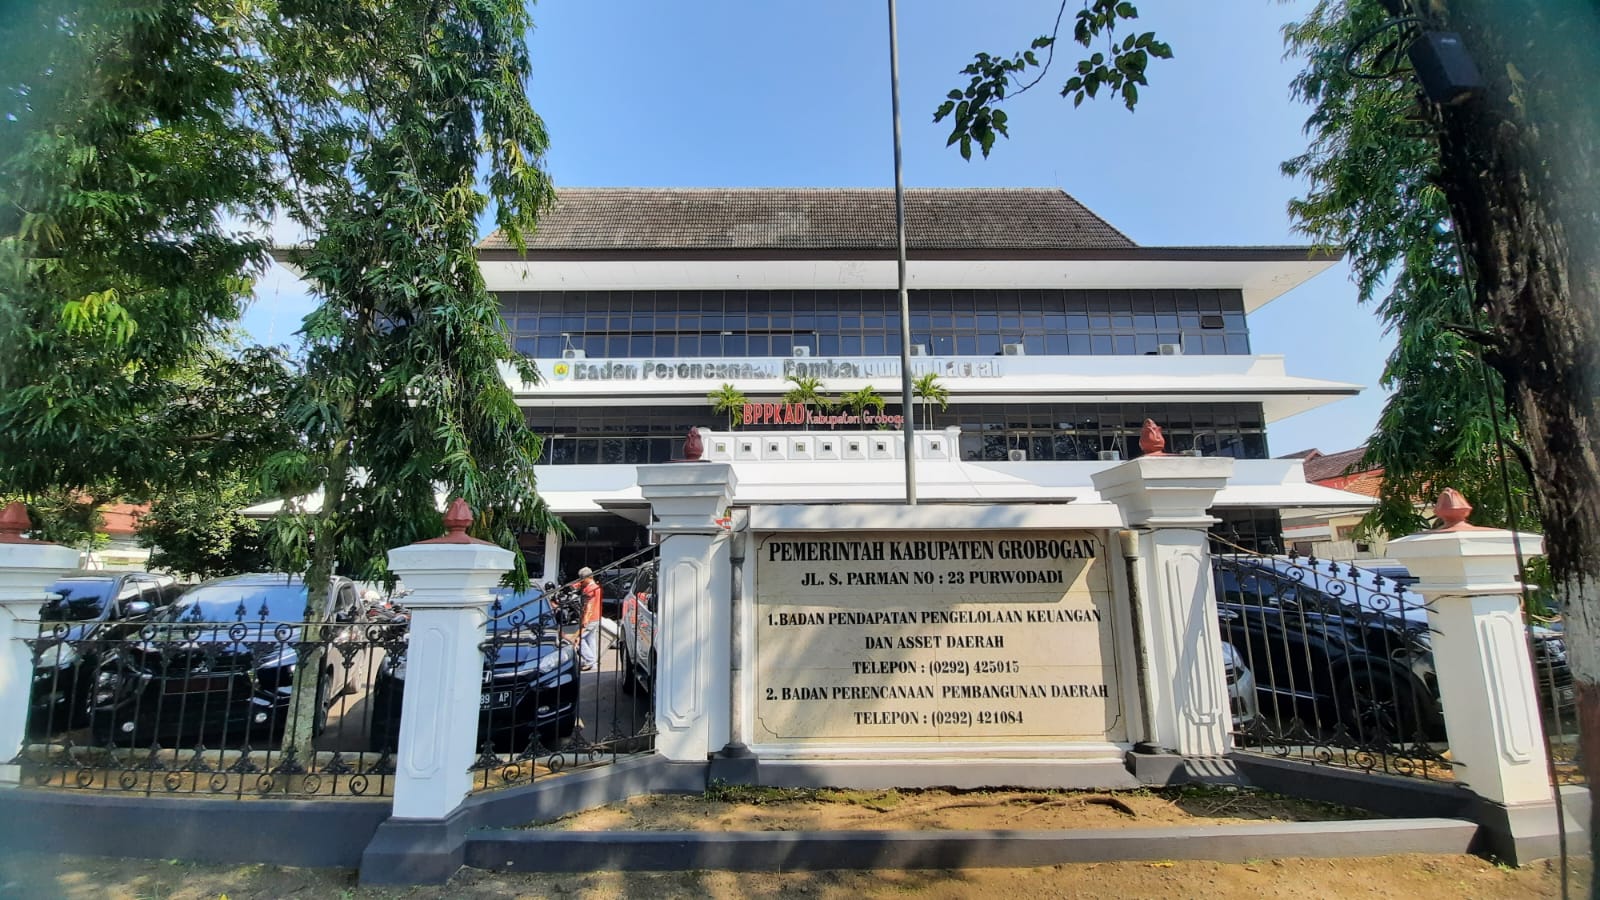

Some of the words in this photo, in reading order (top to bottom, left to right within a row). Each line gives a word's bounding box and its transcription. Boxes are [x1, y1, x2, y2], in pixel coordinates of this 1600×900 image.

[743, 403, 805, 425] BPPKAD
[806, 409, 861, 429] Kabupaten
[863, 409, 904, 429] Grobog
[769, 541, 886, 562] PEMERINTAH
[889, 540, 994, 561] KABUPATEN
[998, 538, 1096, 560] GROBOGAN
[801, 573, 825, 586] JL.
[829, 572, 843, 585] S.
[846, 571, 909, 586] PARMAN
[913, 571, 935, 585] NO
[948, 571, 965, 585] 23
[969, 570, 1064, 585] PURWODADI
[828, 611, 918, 626] PENDAPATAN
[920, 610, 1024, 625] PENGELOLAAN
[1026, 609, 1102, 624] KEUANGAN
[865, 636, 893, 650] DAN
[896, 635, 942, 650] ASSET
[945, 635, 1005, 649] DAERAH
[852, 660, 918, 675] TELEPON
[928, 659, 970, 677] (0292)
[973, 659, 1020, 675] 425015
[480, 694, 490, 704] 89
[498, 692, 510, 702] AP
[781, 687, 829, 701] BADAN
[831, 685, 935, 700] PERENCANAAN
[942, 684, 1047, 699] PEMBANGUNAN
[1050, 684, 1109, 699] DAERAH
[854, 711, 920, 725] TELEPON
[931, 711, 973, 729] (0292)
[976, 710, 1024, 725] 421084
